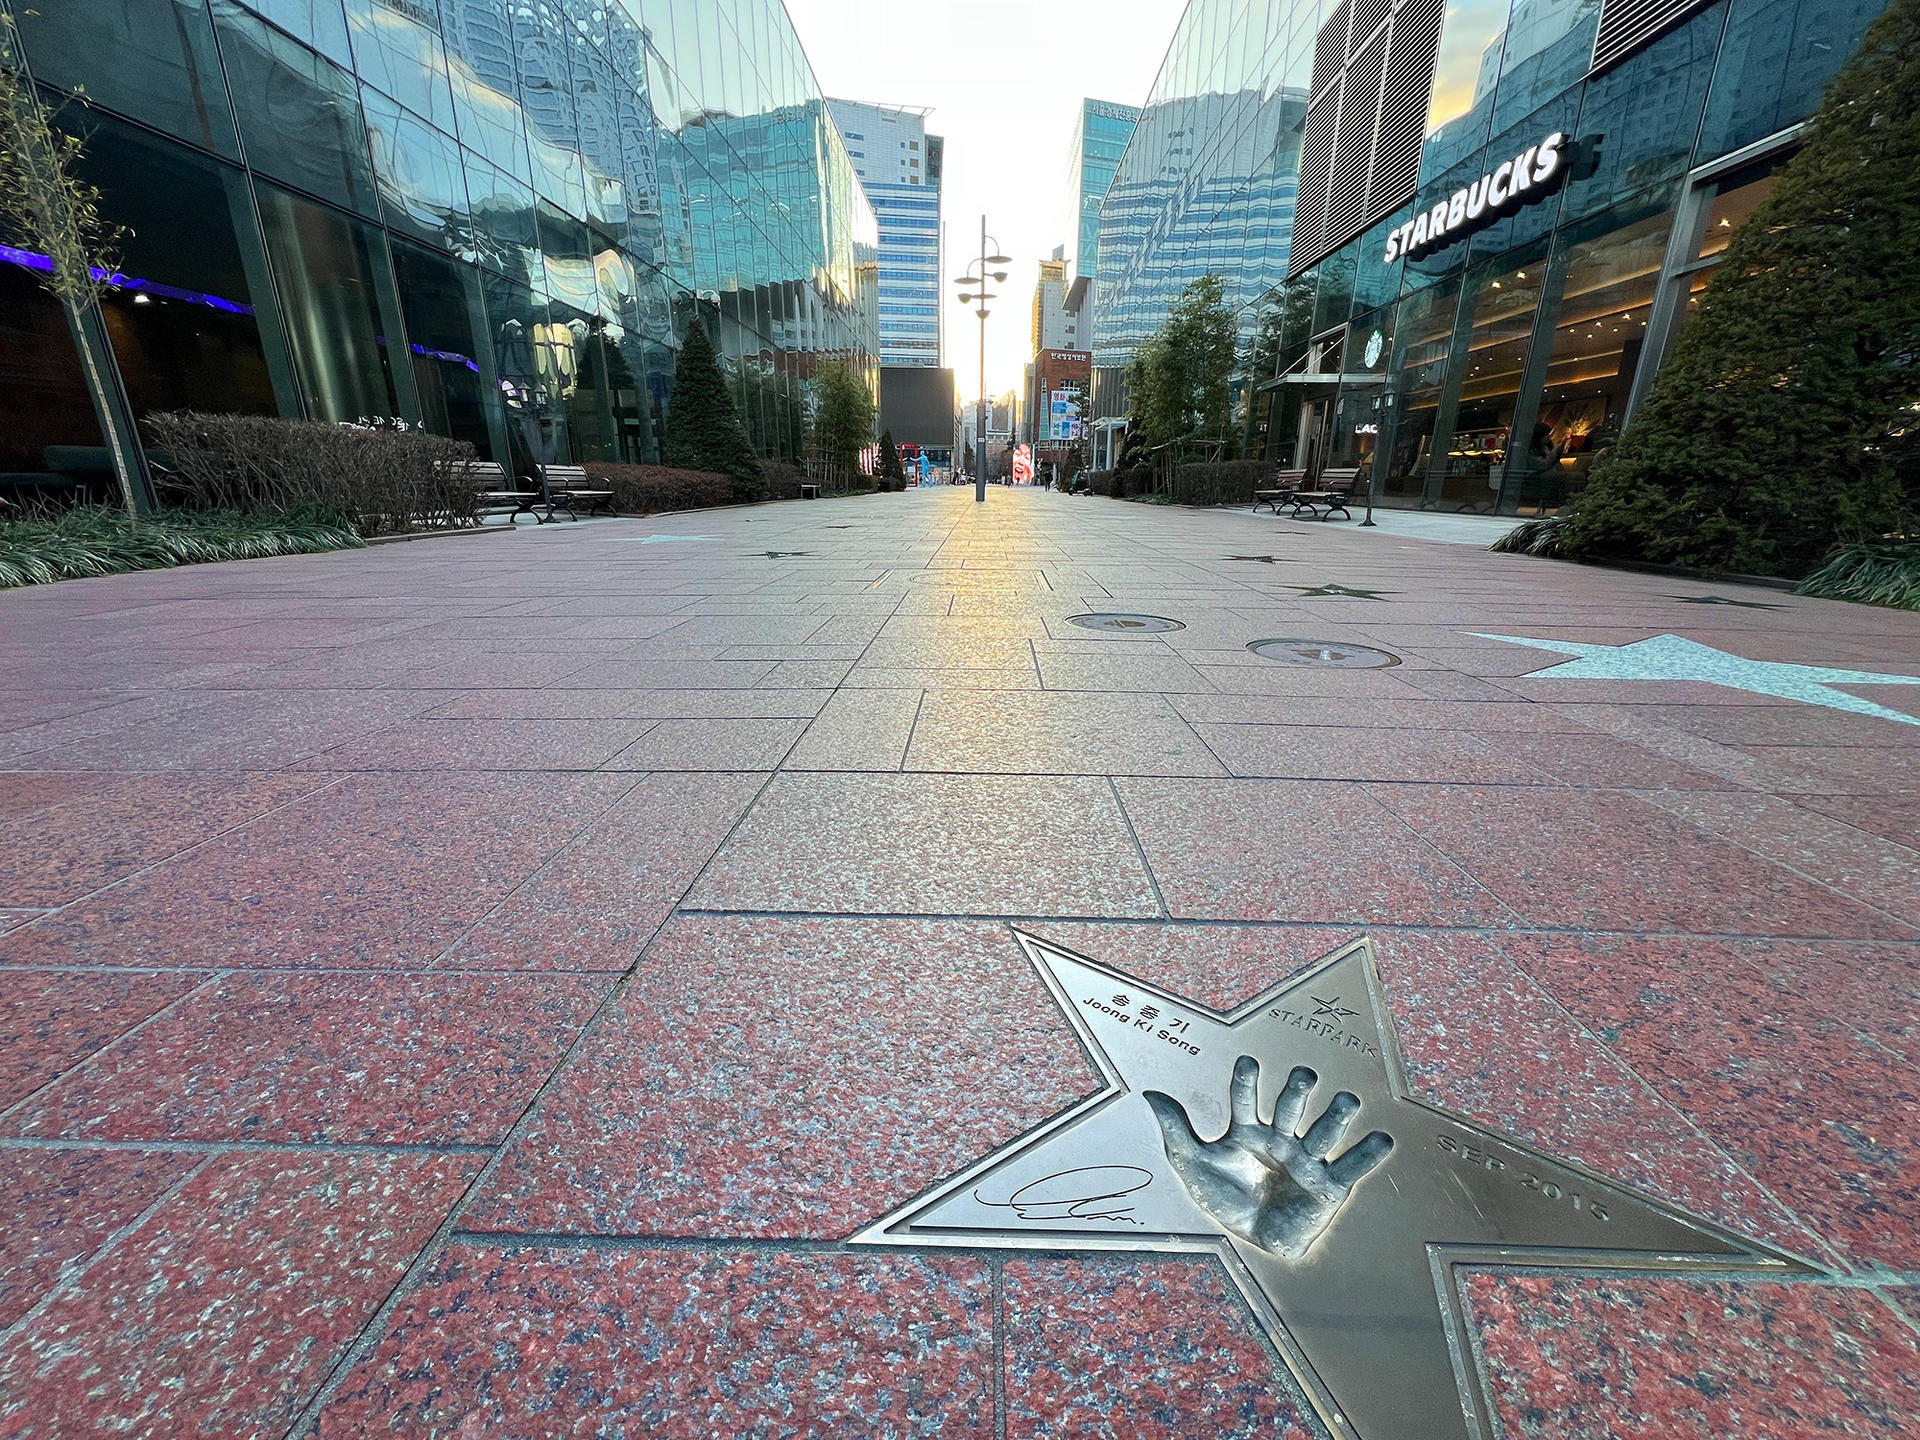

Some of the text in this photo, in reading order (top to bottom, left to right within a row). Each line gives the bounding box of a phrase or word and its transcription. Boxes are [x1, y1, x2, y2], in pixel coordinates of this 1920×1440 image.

[1384, 132, 1563, 263] STARBUCKS
[1083, 997, 1201, 1056] Joong Ki Song
[1268, 1008, 1379, 1059] STARPARK
[1437, 1134, 1611, 1221] SEP 2015
